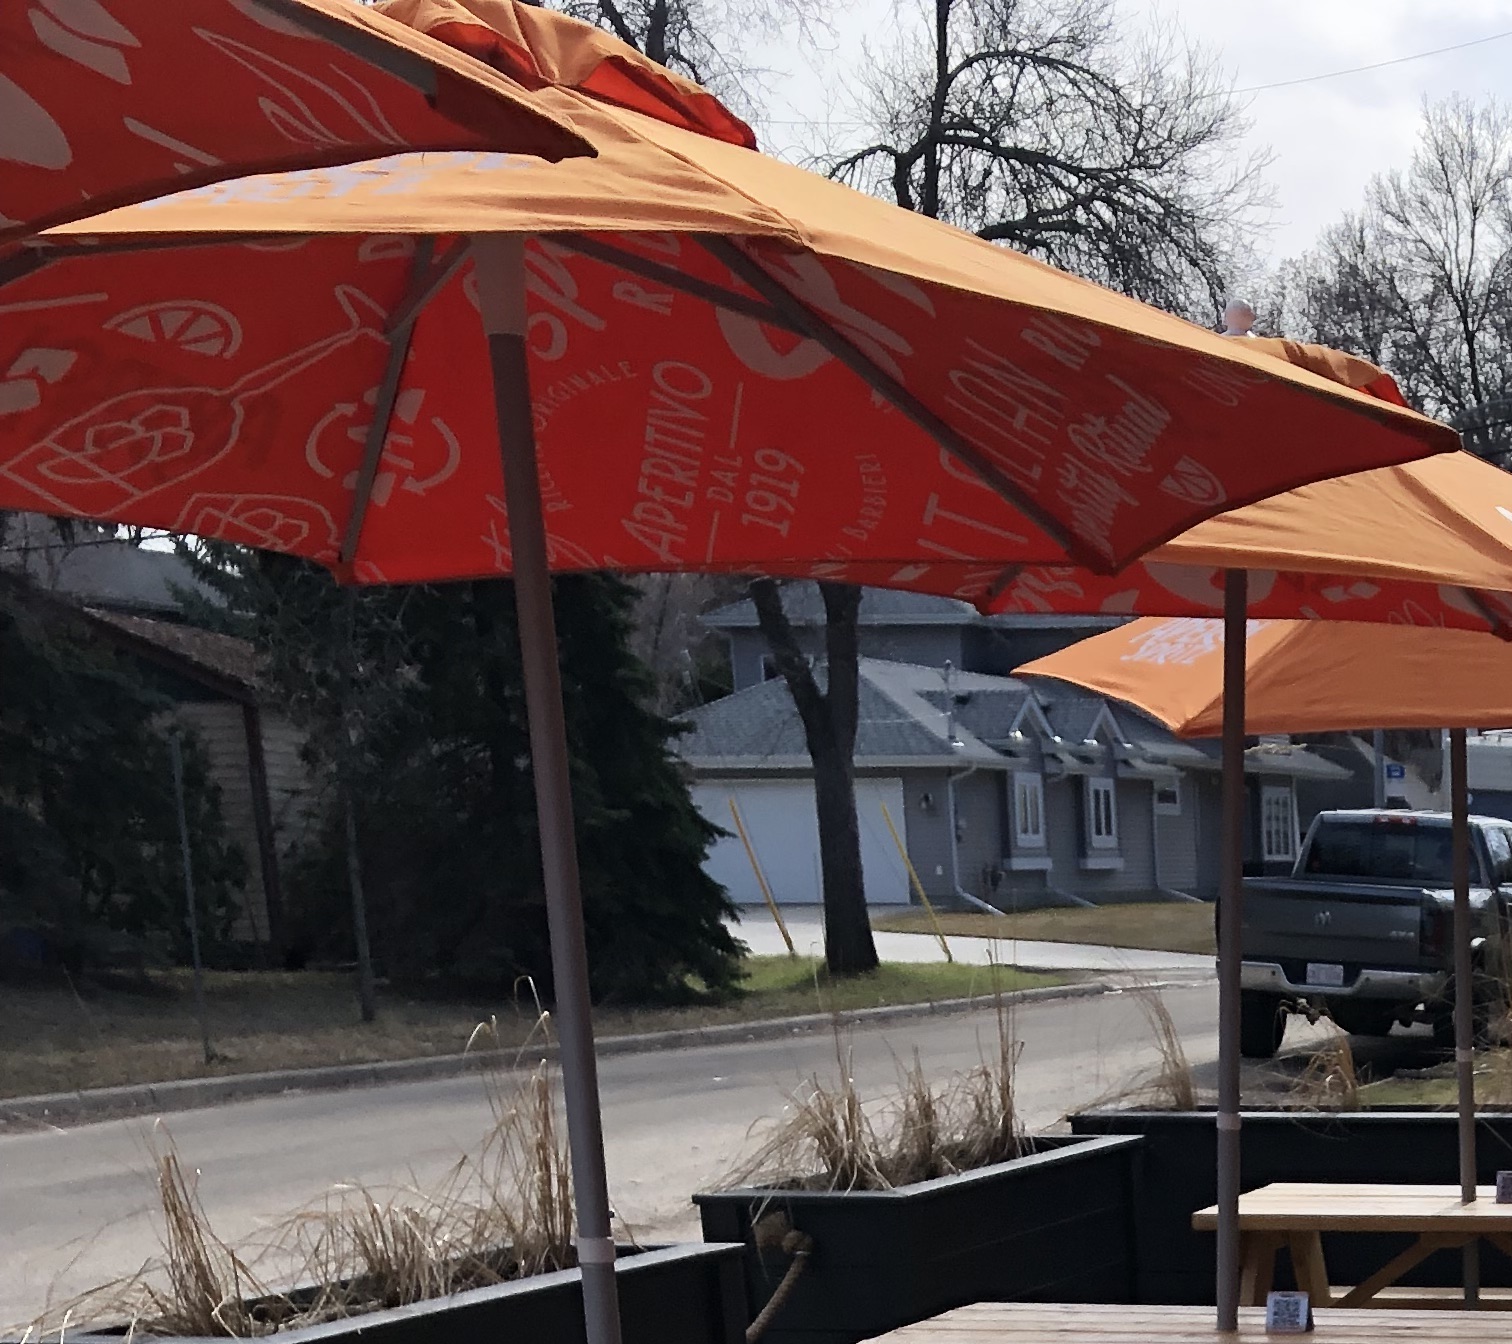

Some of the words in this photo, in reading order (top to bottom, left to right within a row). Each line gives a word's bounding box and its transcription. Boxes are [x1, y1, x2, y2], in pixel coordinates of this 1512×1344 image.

[621, 360, 713, 568] APERITIVO
[706, 455, 744, 504] DAL
[741, 448, 805, 539] 1919
